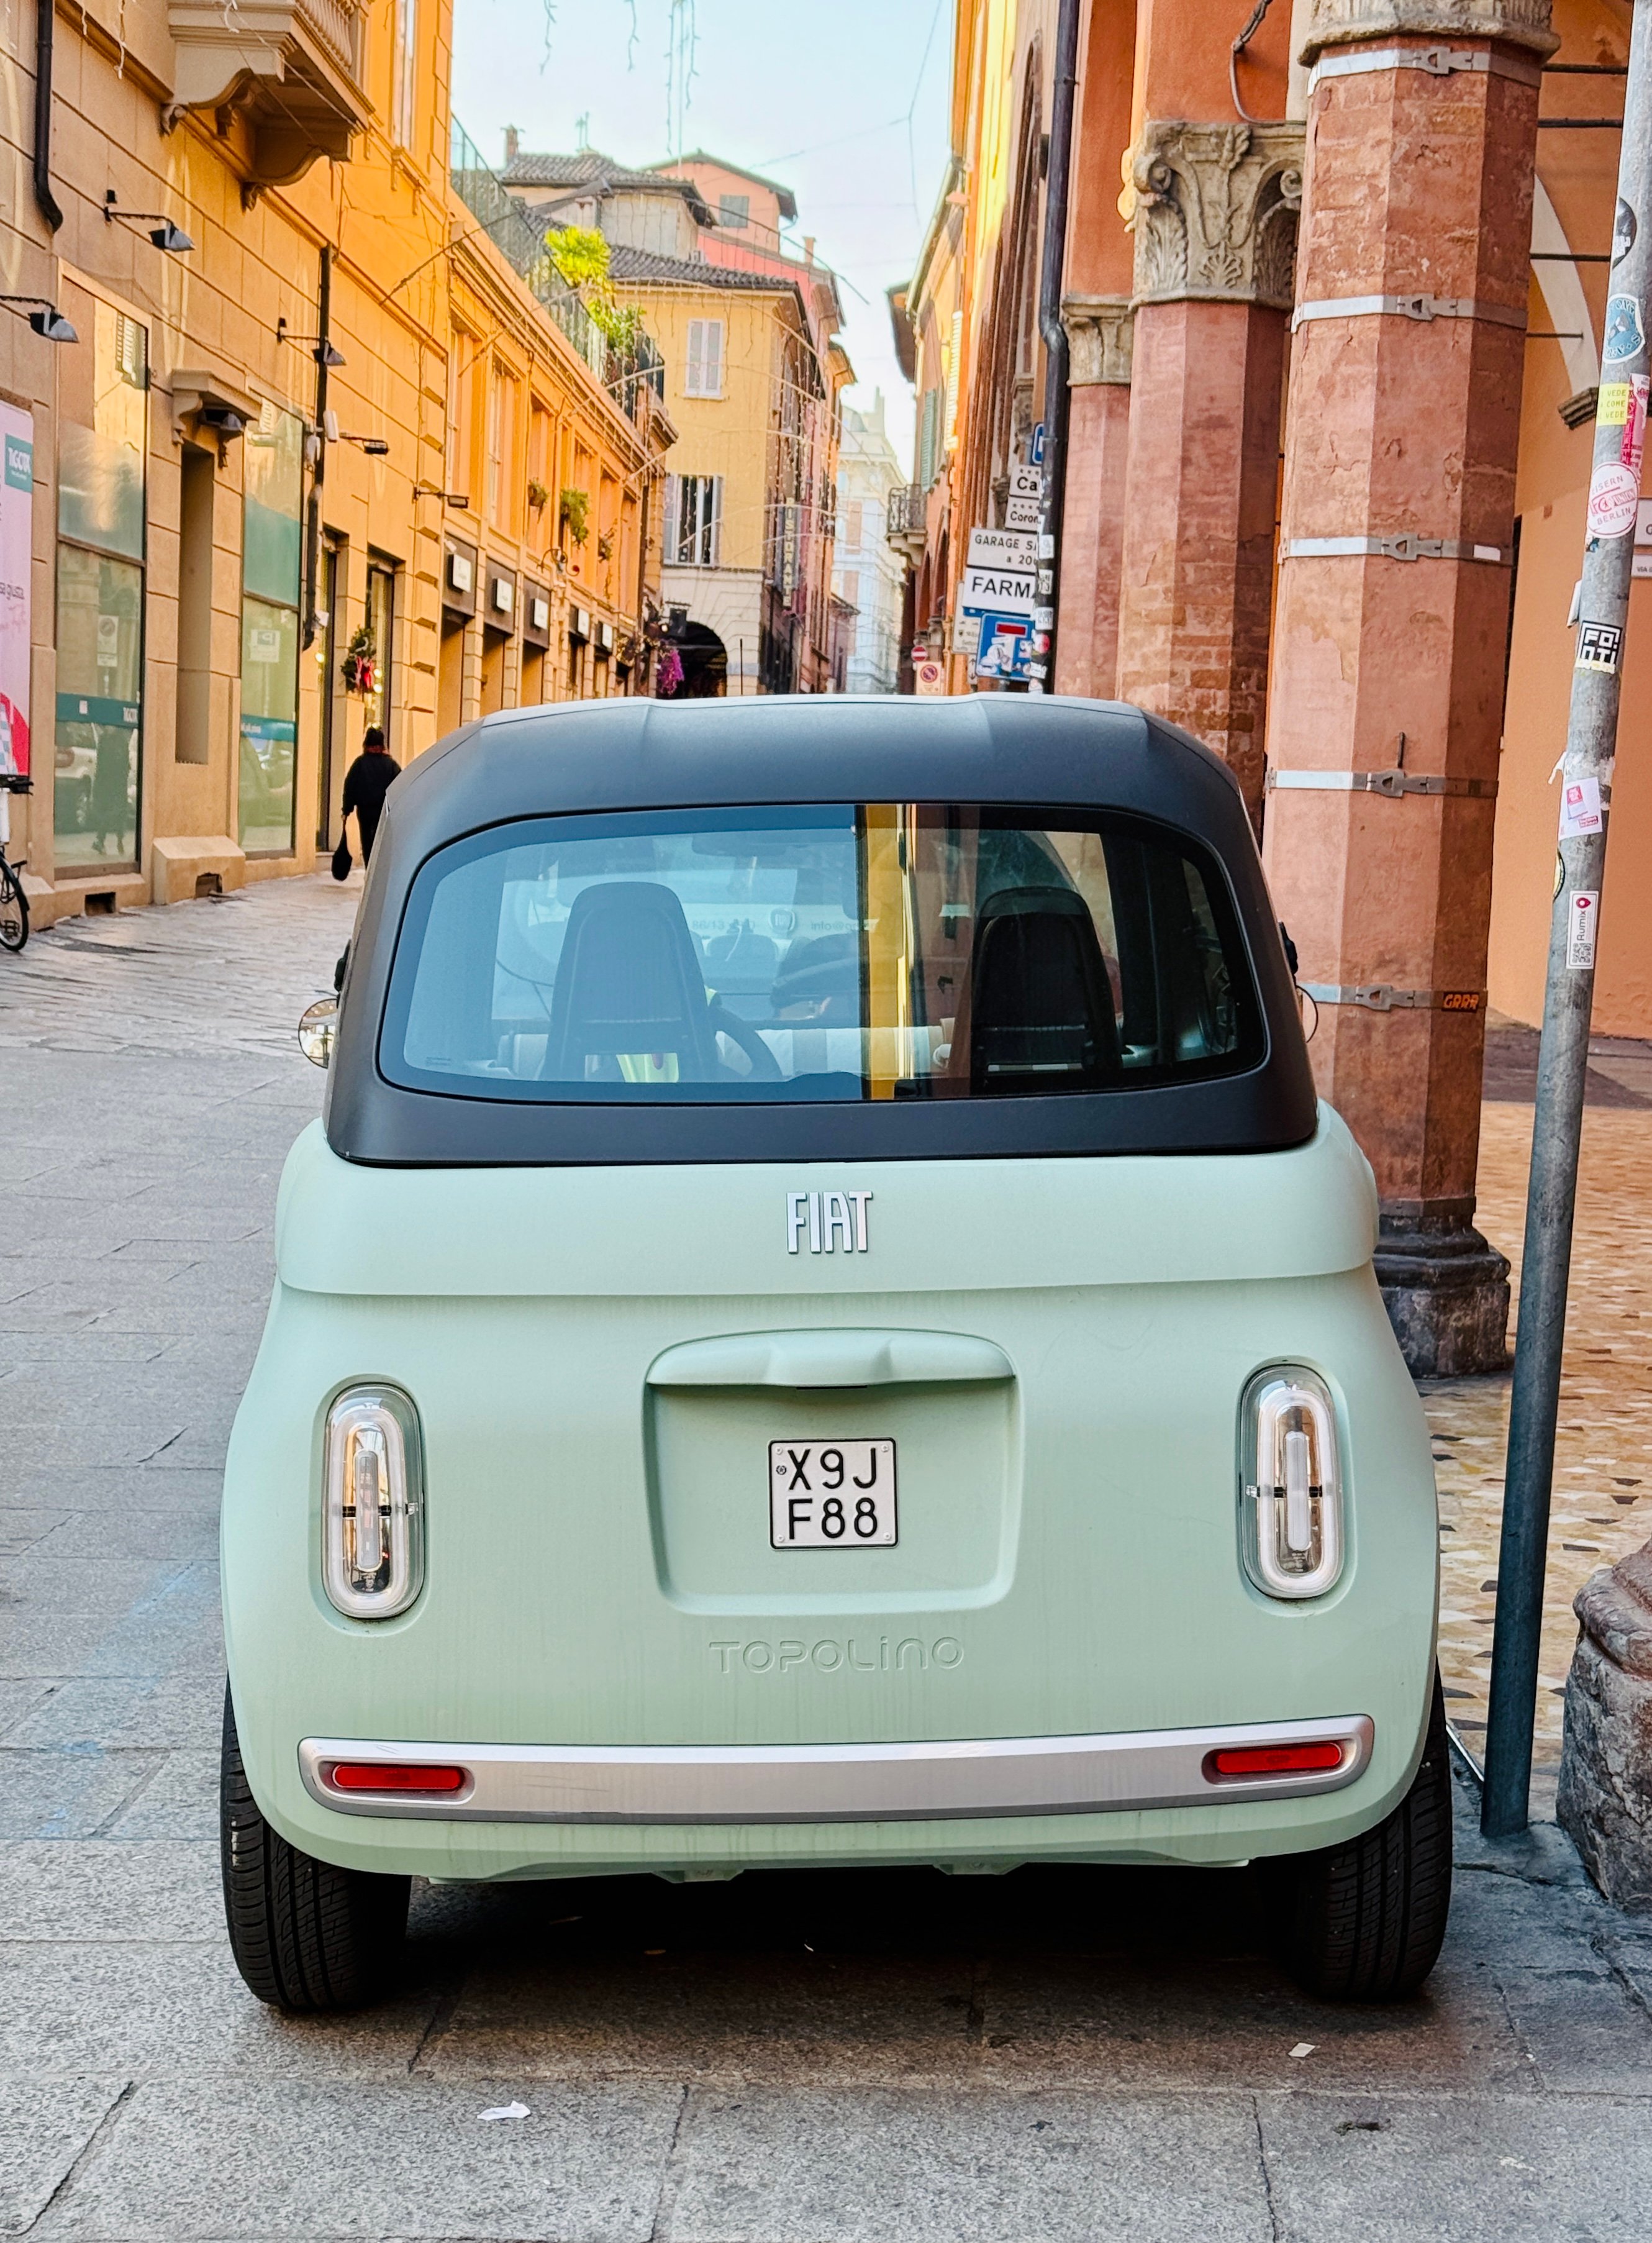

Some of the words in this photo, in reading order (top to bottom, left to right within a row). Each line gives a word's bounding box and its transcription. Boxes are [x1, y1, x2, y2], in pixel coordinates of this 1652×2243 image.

[1597, 507, 1631, 526] BERLIN
[975, 534, 1020, 549] GARAGE
[1576, 910, 1586, 941] Rumix
[786, 1191, 873, 1255] FIAT
[787, 1447, 876, 1490] X9J
[788, 1497, 878, 1540] F88
